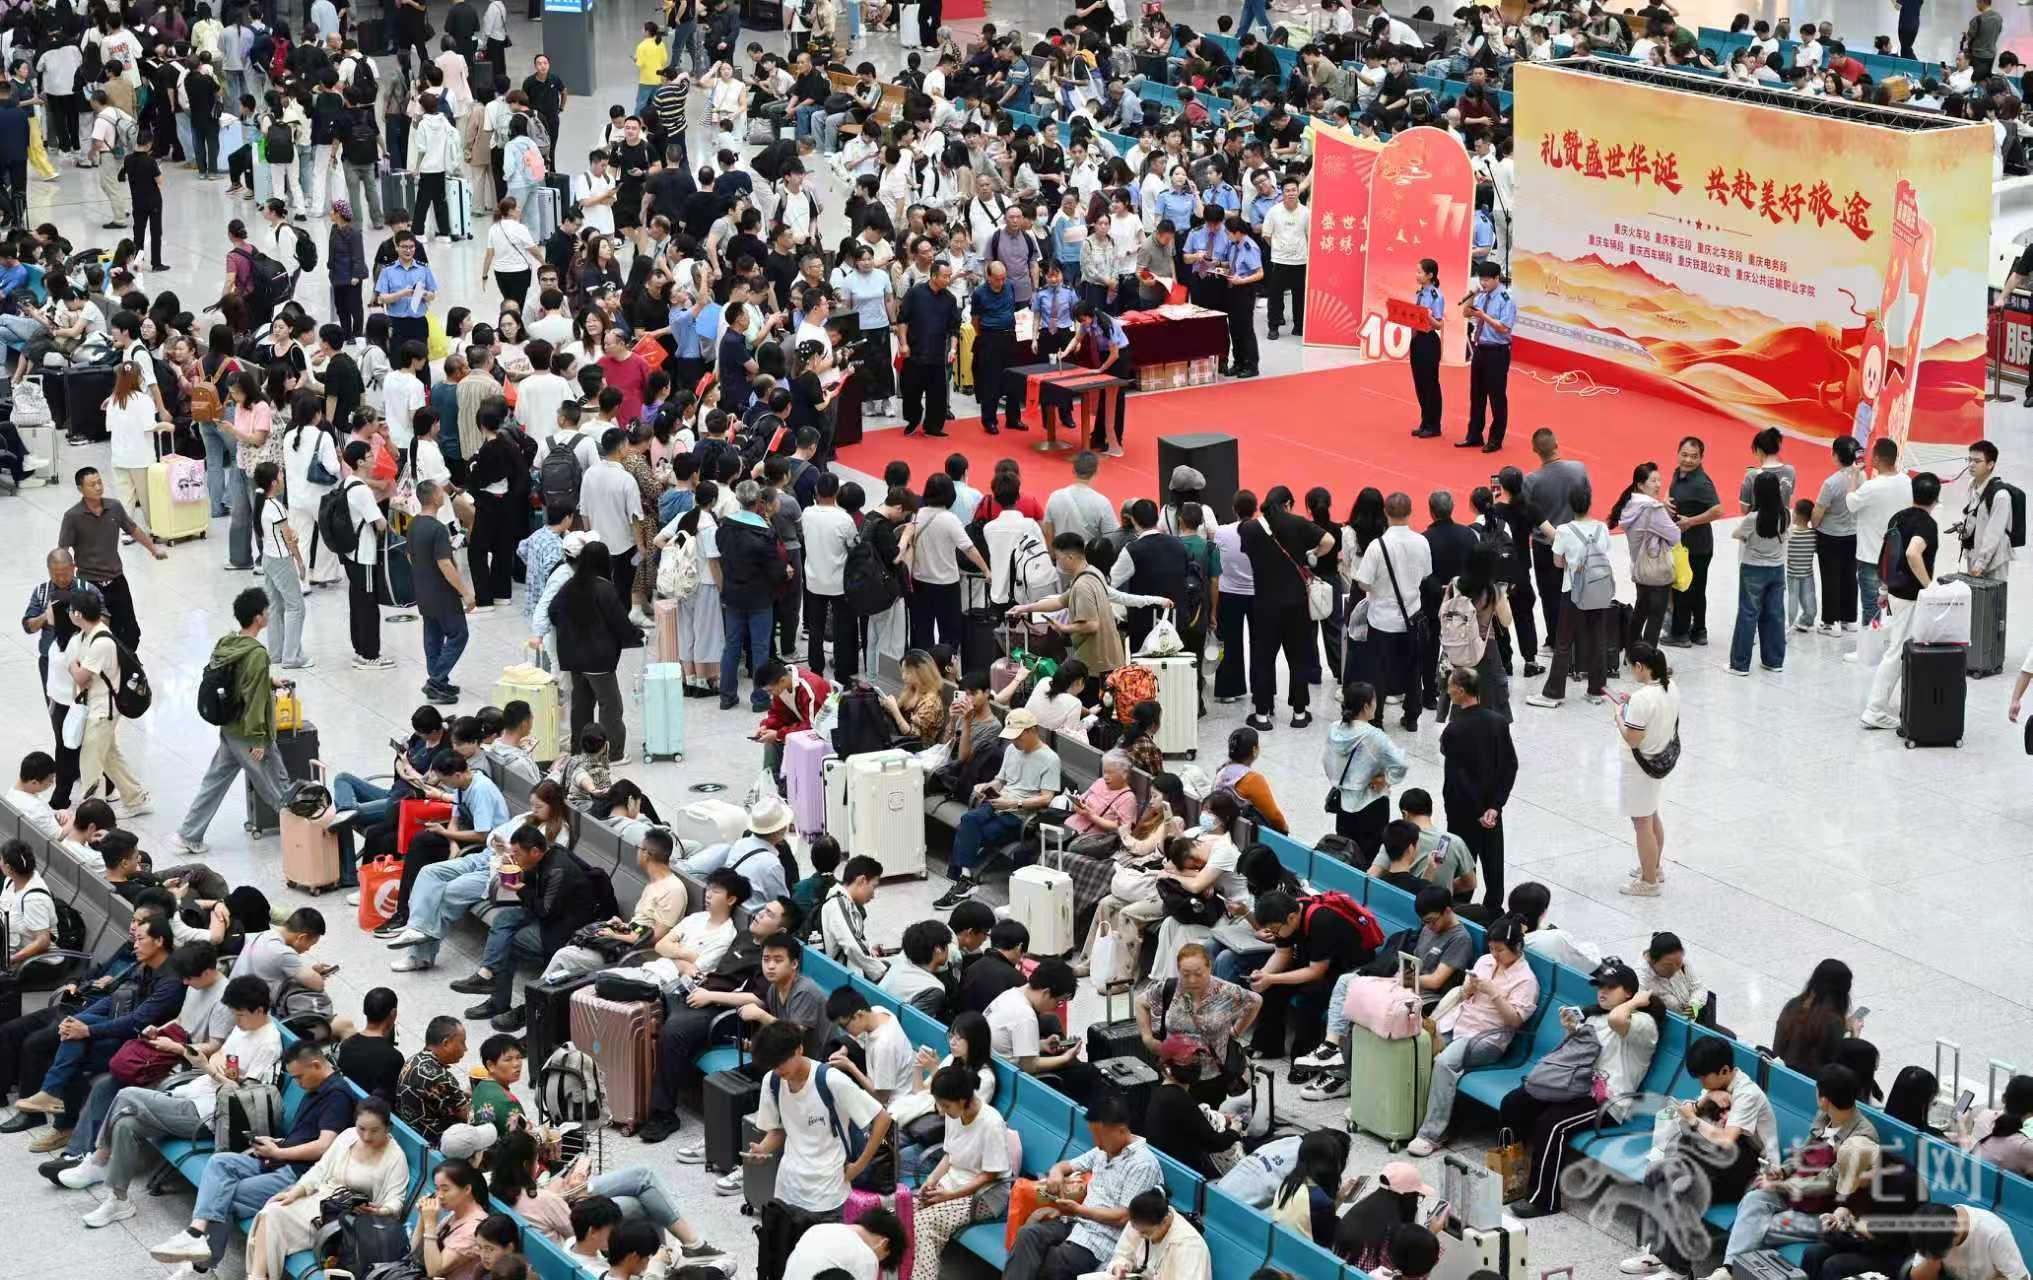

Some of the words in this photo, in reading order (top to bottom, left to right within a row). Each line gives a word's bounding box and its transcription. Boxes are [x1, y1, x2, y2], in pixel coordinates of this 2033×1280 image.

[1541, 129, 1683, 195] 礼赞盛世华诞
[1705, 166, 1873, 241] 共赴美好旅途
[1589, 235, 1624, 252] 重庆车辆段
[1679, 255, 1731, 278] 重庆铁路公安处
[1615, 224, 1651, 241] 重庆火车站
[1656, 233, 1692, 251] 重庆客运段
[1749, 254, 1787, 273] 重庆电务段
[2005, 321, 2032, 365] 服
